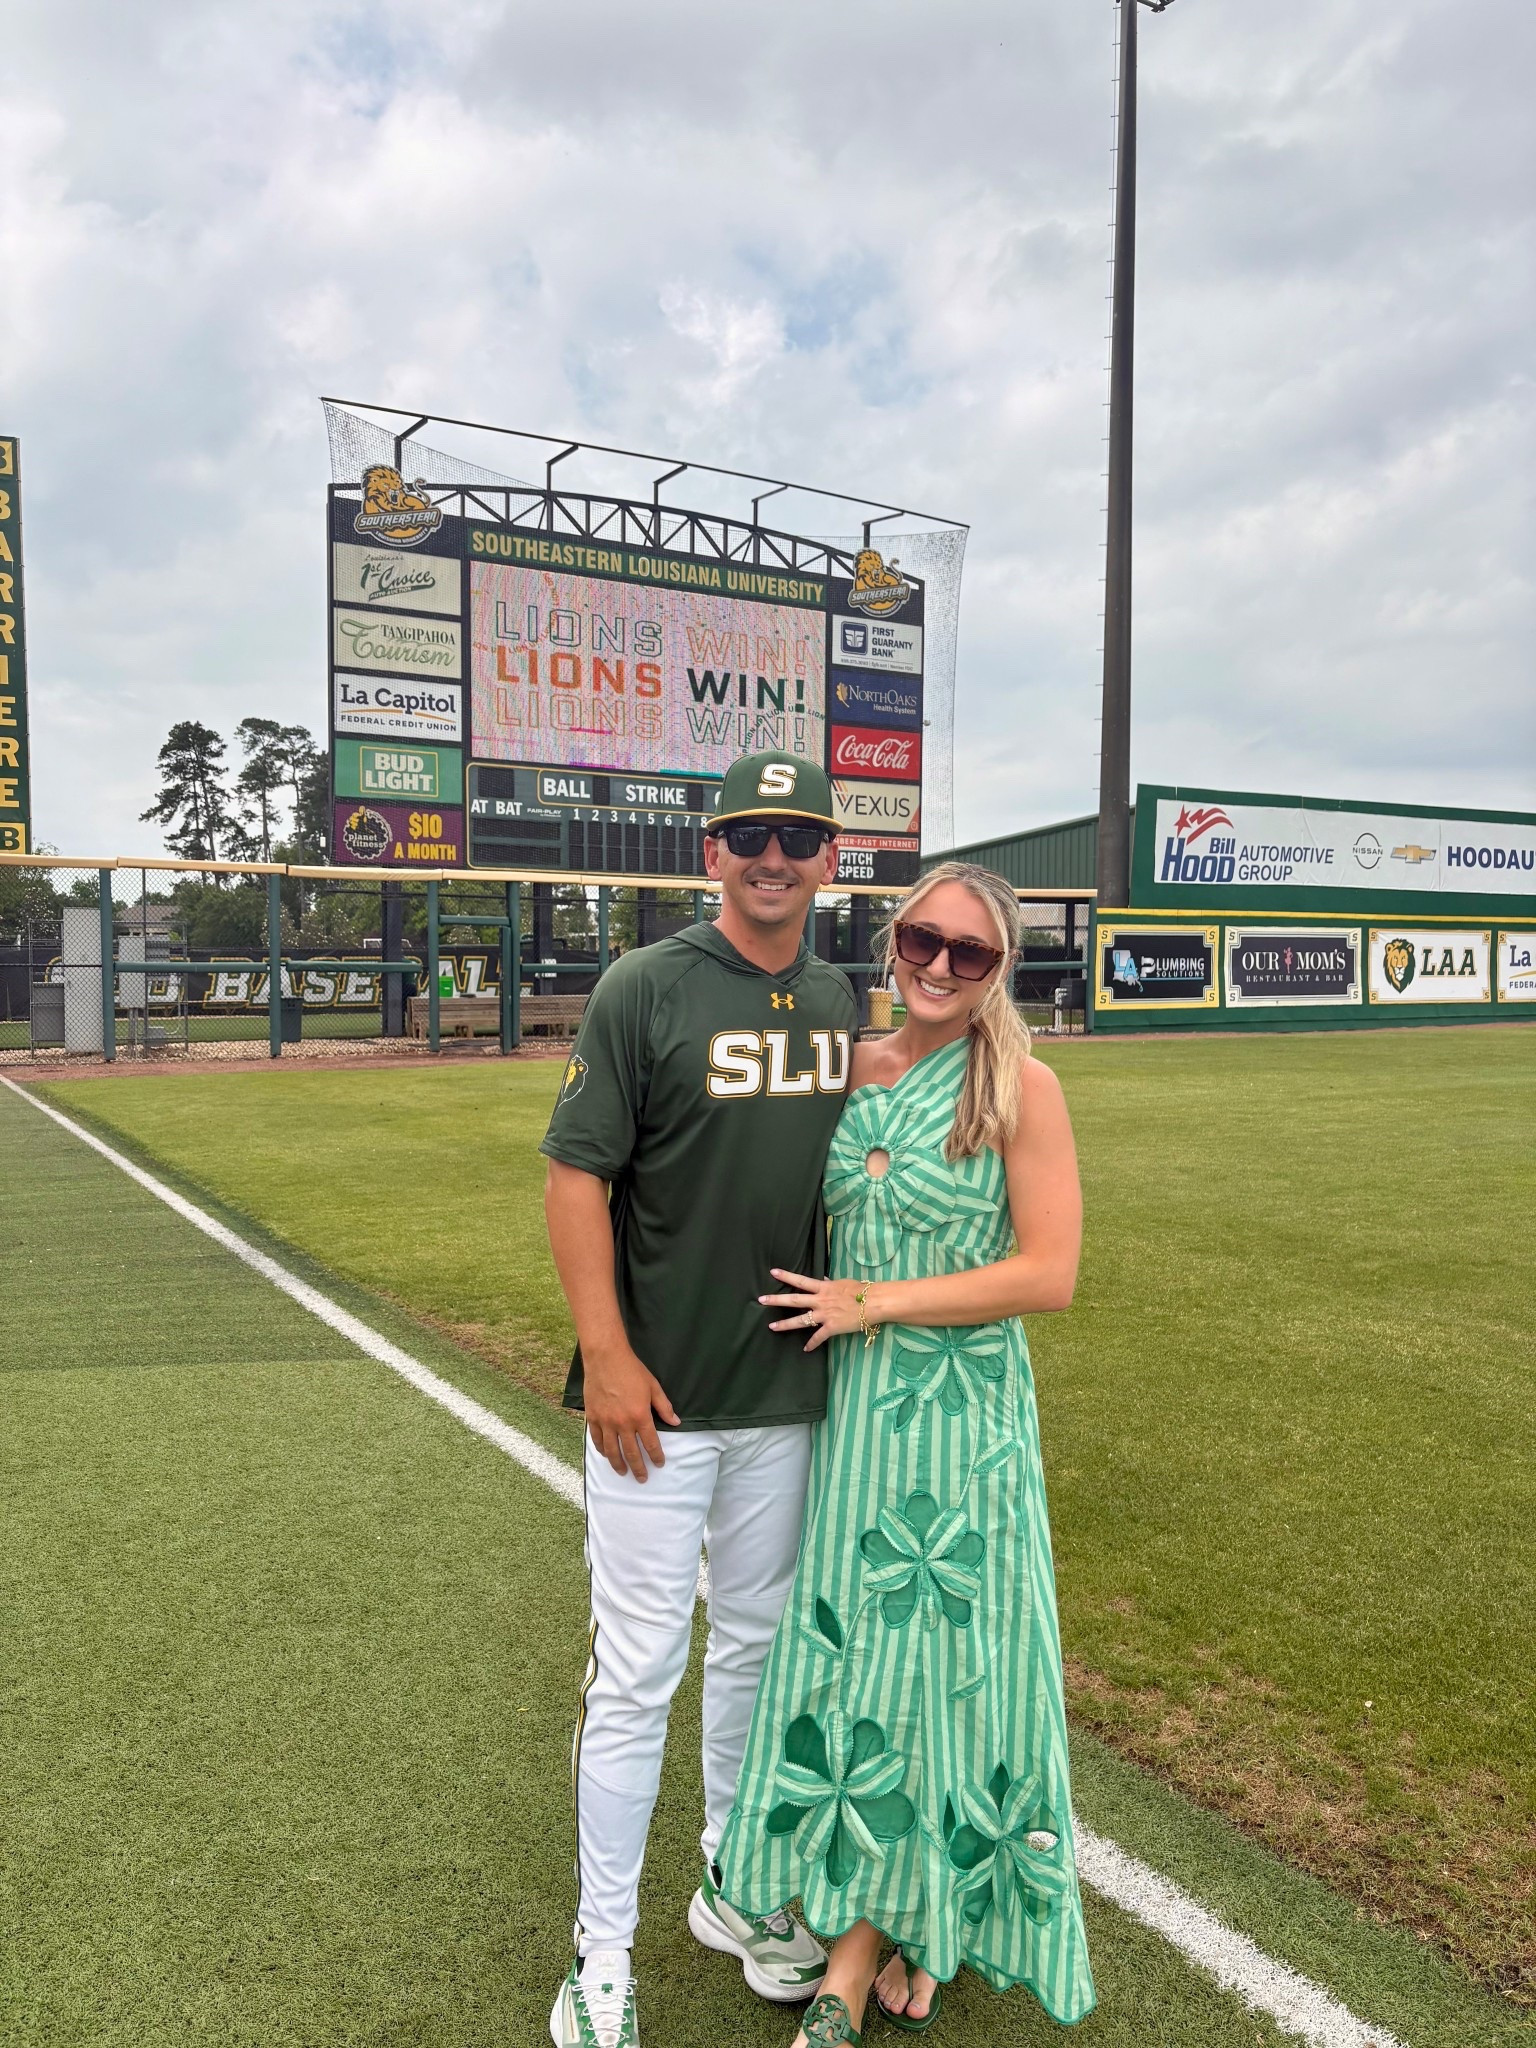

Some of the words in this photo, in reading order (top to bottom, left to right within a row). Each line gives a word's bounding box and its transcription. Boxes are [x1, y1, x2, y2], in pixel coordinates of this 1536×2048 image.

[359, 511, 437, 527] SOUTHEASTERN
[472, 531, 622, 574] SOUTHEASTERN
[629, 555, 722, 588] LOUISIANA
[727, 570, 824, 603] UNIVERSITY
[340, 618, 456, 667] Tourism
[381, 624, 456, 646] TANGIPAHOA
[496, 601, 663, 658] LIONS
[686, 626, 806, 676] WIN!
[872, 626, 895, 638] FIRST
[872, 637, 913, 650] GUARANTY
[872, 648, 894, 658] BANK
[496, 645, 663, 699] LIONS
[687, 667, 806, 714] WIN!
[341, 684, 369, 705] La
[374, 688, 456, 715] Capitol
[873, 703, 893, 713] Health
[893, 706, 916, 715] System
[341, 715, 386, 726] FEDERAL
[388, 718, 423, 730] CREDIT
[427, 722, 457, 732] UNION
[496, 687, 664, 741] LIONS
[686, 707, 806, 753] WIN!
[374, 752, 424, 773] BUD
[836, 734, 914, 770] Coca-Cola
[365, 770, 434, 792] LIGHT
[757, 763, 797, 797] S
[543, 778, 591, 799] BALL
[625, 783, 686, 806] STRIKE
[470, 800, 488, 814] AT
[495, 801, 523, 816] BAT
[835, 793, 910, 818] VEXUS
[408, 811, 443, 840] $10
[573, 808, 579, 820] 1
[591, 809, 600, 821] 2
[610, 811, 618, 823] 3
[628, 812, 637, 824] 4
[647, 813, 655, 825] 5
[665, 814, 672, 826] 6
[684, 815, 691, 827] 7
[700, 816, 708, 828] 8
[348, 832, 378, 843] planet
[352, 840, 385, 849] fitness
[879, 839, 917, 849] INTERNET
[1209, 837, 1236, 855] Bill
[394, 842, 405, 859] A
[407, 843, 457, 860] MONTH
[839, 851, 873, 866] PITCH
[1160, 836, 1236, 883] HOOD
[1238, 845, 1335, 864] AUTOMOTIVE
[1352, 847, 1383, 856] NISSAN
[1447, 845, 1536, 870] HOODAU
[837, 865, 874, 879] SPEED
[1238, 864, 1293, 881] GROUP
[1140, 955, 1205, 978] PLUMBING
[1241, 951, 1279, 970] OUR
[1296, 948, 1346, 971] MOM'S
[1419, 946, 1477, 978] LAA
[1509, 945, 1532, 967] La
[203, 956, 534, 1009] BASEAL
[1246, 974, 1311, 983] RESTAURANT
[1325, 974, 1343, 982] BAR
[706, 1029, 850, 1099] SLU
